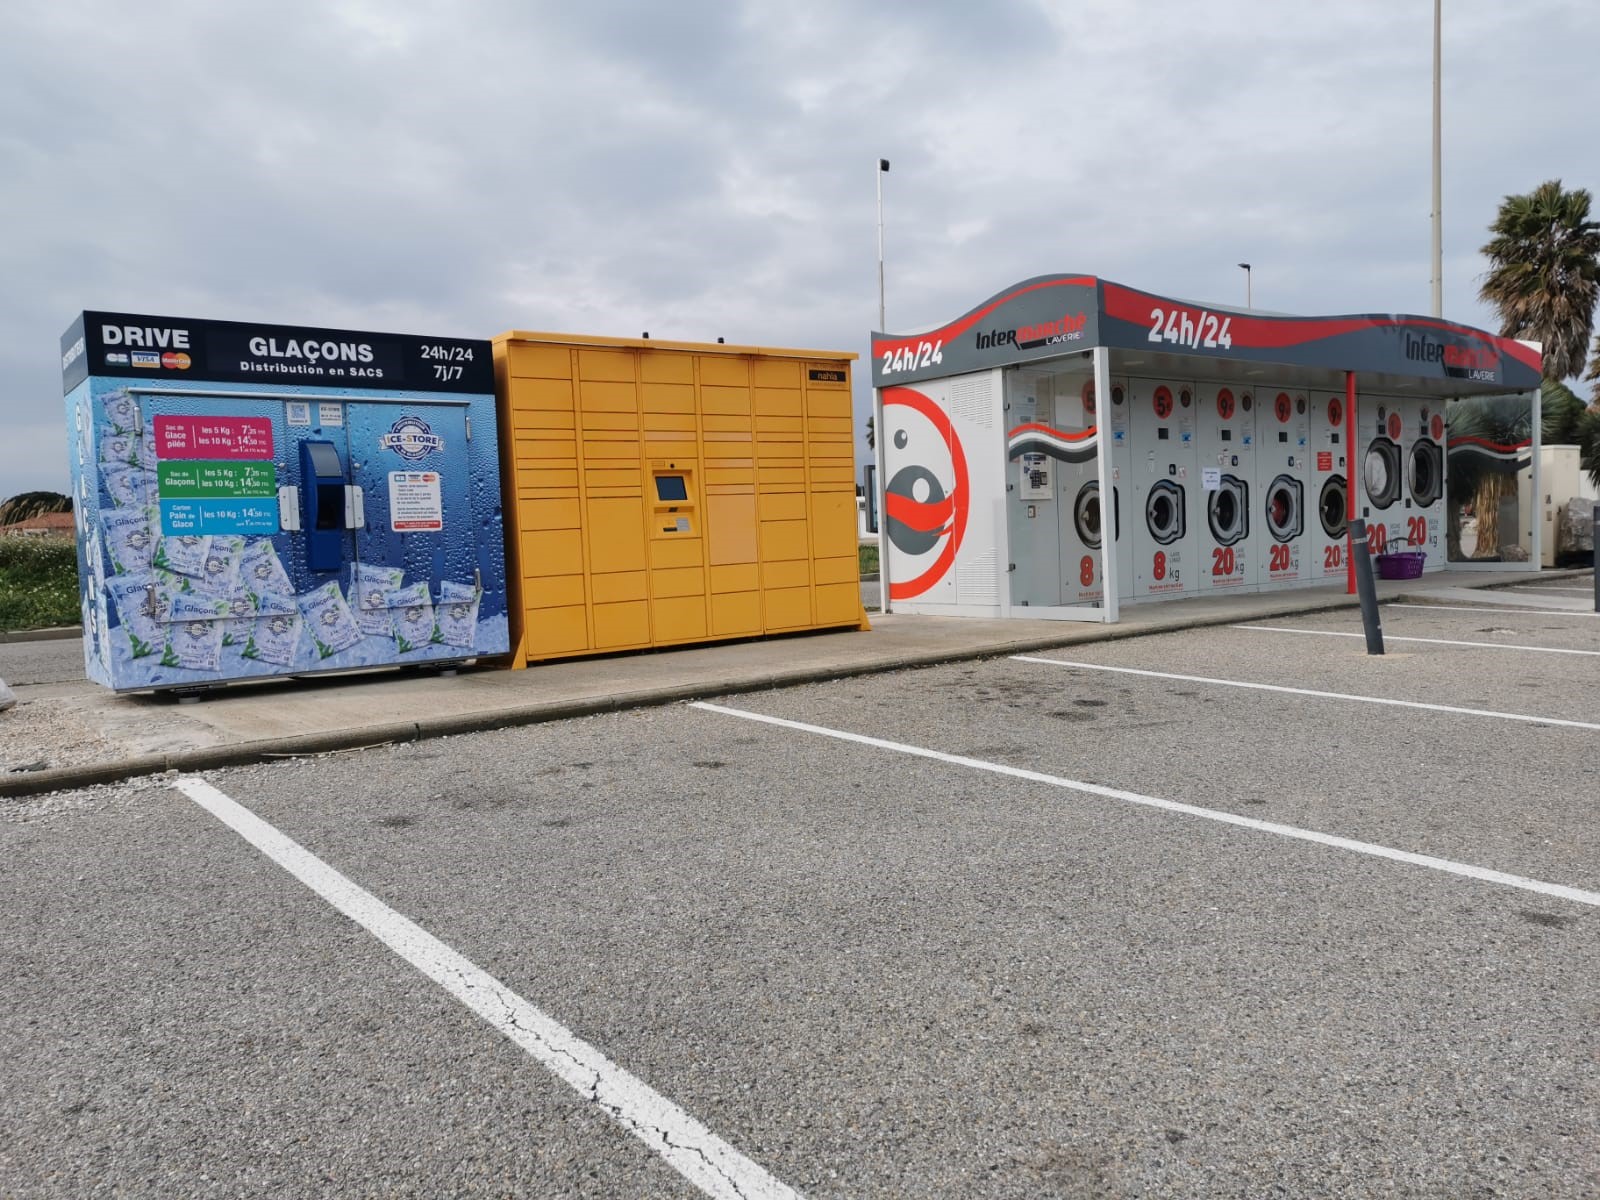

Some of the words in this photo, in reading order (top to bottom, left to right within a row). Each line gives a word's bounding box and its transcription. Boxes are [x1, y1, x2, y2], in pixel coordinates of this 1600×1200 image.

[102, 325, 190, 349] DRIVE
[1148, 308, 1232, 350] 24h/24
[1045, 332, 1081, 345] LAVERIE
[249, 337, 374, 364] GLAÇONS
[420, 345, 474, 361] 24h/24
[881, 339, 943, 375] 24h/24
[240, 361, 324, 375] Distribution
[329, 367, 344, 375] en
[349, 367, 384, 378] SACS
[433, 365, 463, 381] 7j/7
[1468, 369, 1496, 381] LAVERIE
[165, 431, 186, 439] Glace
[387, 434, 438, 445] ICE-STORE
[224, 469, 233, 478] Kg
[165, 478, 195, 487] Glaçons
[225, 480, 234, 488] Kg
[115, 516, 149, 527] Glaçons
[170, 511, 186, 519] Pain
[227, 511, 236, 519] Kg
[173, 520, 194, 528] Glace
[1408, 516, 1427, 547] 20
[1366, 522, 1387, 555] 20
[1212, 547, 1234, 576] 20
[1235, 560, 1245, 575] kg
[1269, 544, 1290, 572] 20
[1324, 545, 1341, 568] 20
[1080, 555, 1094, 587] 8
[1153, 551, 1166, 581] 8
[1169, 567, 1180, 582] kg
[184, 604, 218, 616] Glaçons
